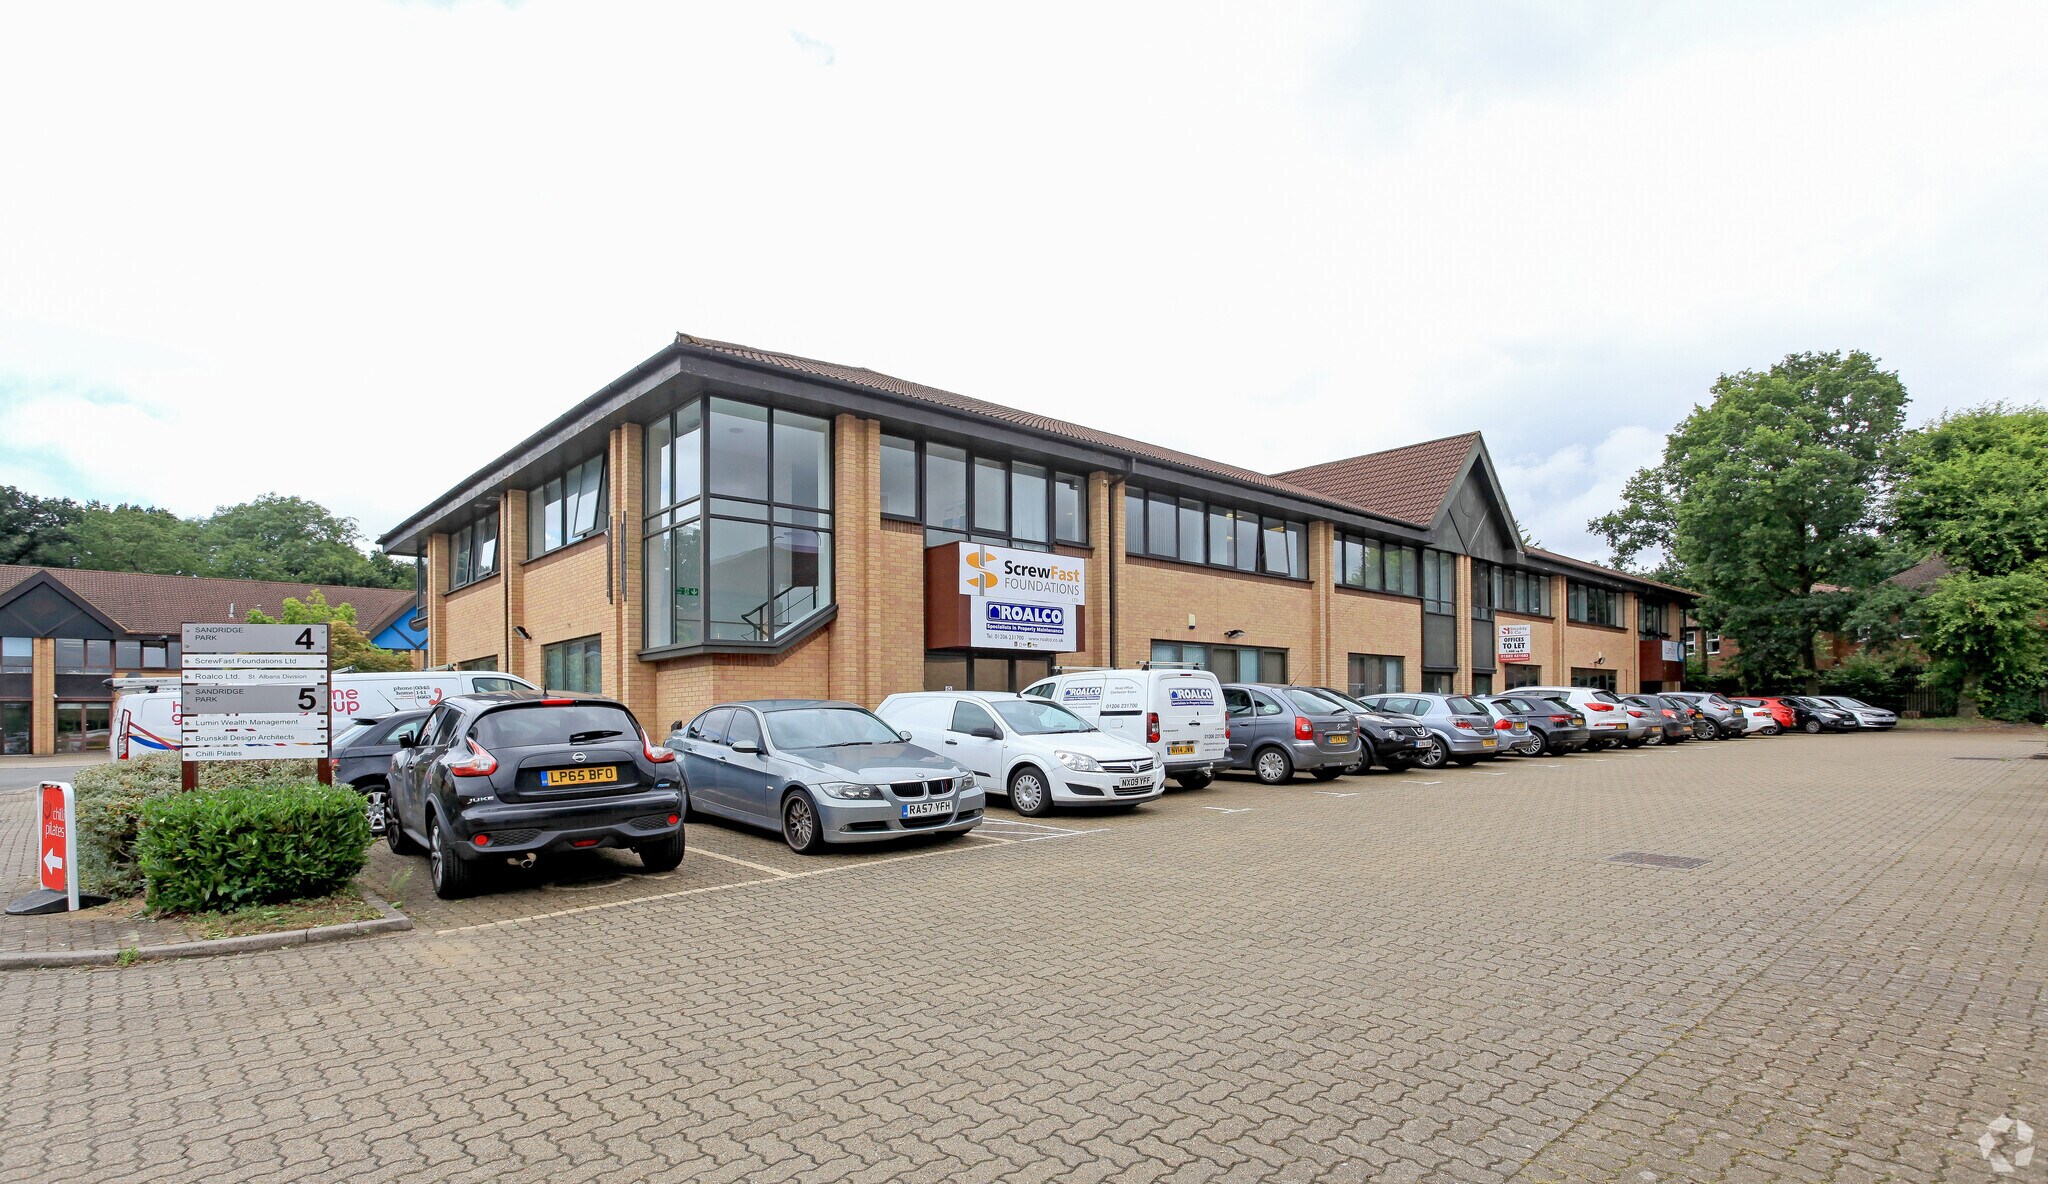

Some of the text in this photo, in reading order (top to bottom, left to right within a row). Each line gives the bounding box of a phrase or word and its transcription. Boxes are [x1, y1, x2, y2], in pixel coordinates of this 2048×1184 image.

[1004, 560, 1080, 582] ScrewFast
[1004, 577, 1080, 596] FOUNDATIONS
[1001, 605, 1062, 624] ROALCO
[295, 627, 315, 650] 4
[1069, 687, 1100, 696] ROALCO
[1178, 688, 1212, 699] ROALCO
[297, 688, 317, 711] 5
[249, 719, 299, 727] Management
[230, 734, 256, 742] Design
[551, 768, 613, 783] LP65 BFO
[1122, 776, 1150, 786] NX09 YFF
[467, 796, 494, 804] JUKE
[910, 801, 950, 814] RA57 YFH
[46, 821, 65, 838] pilates
